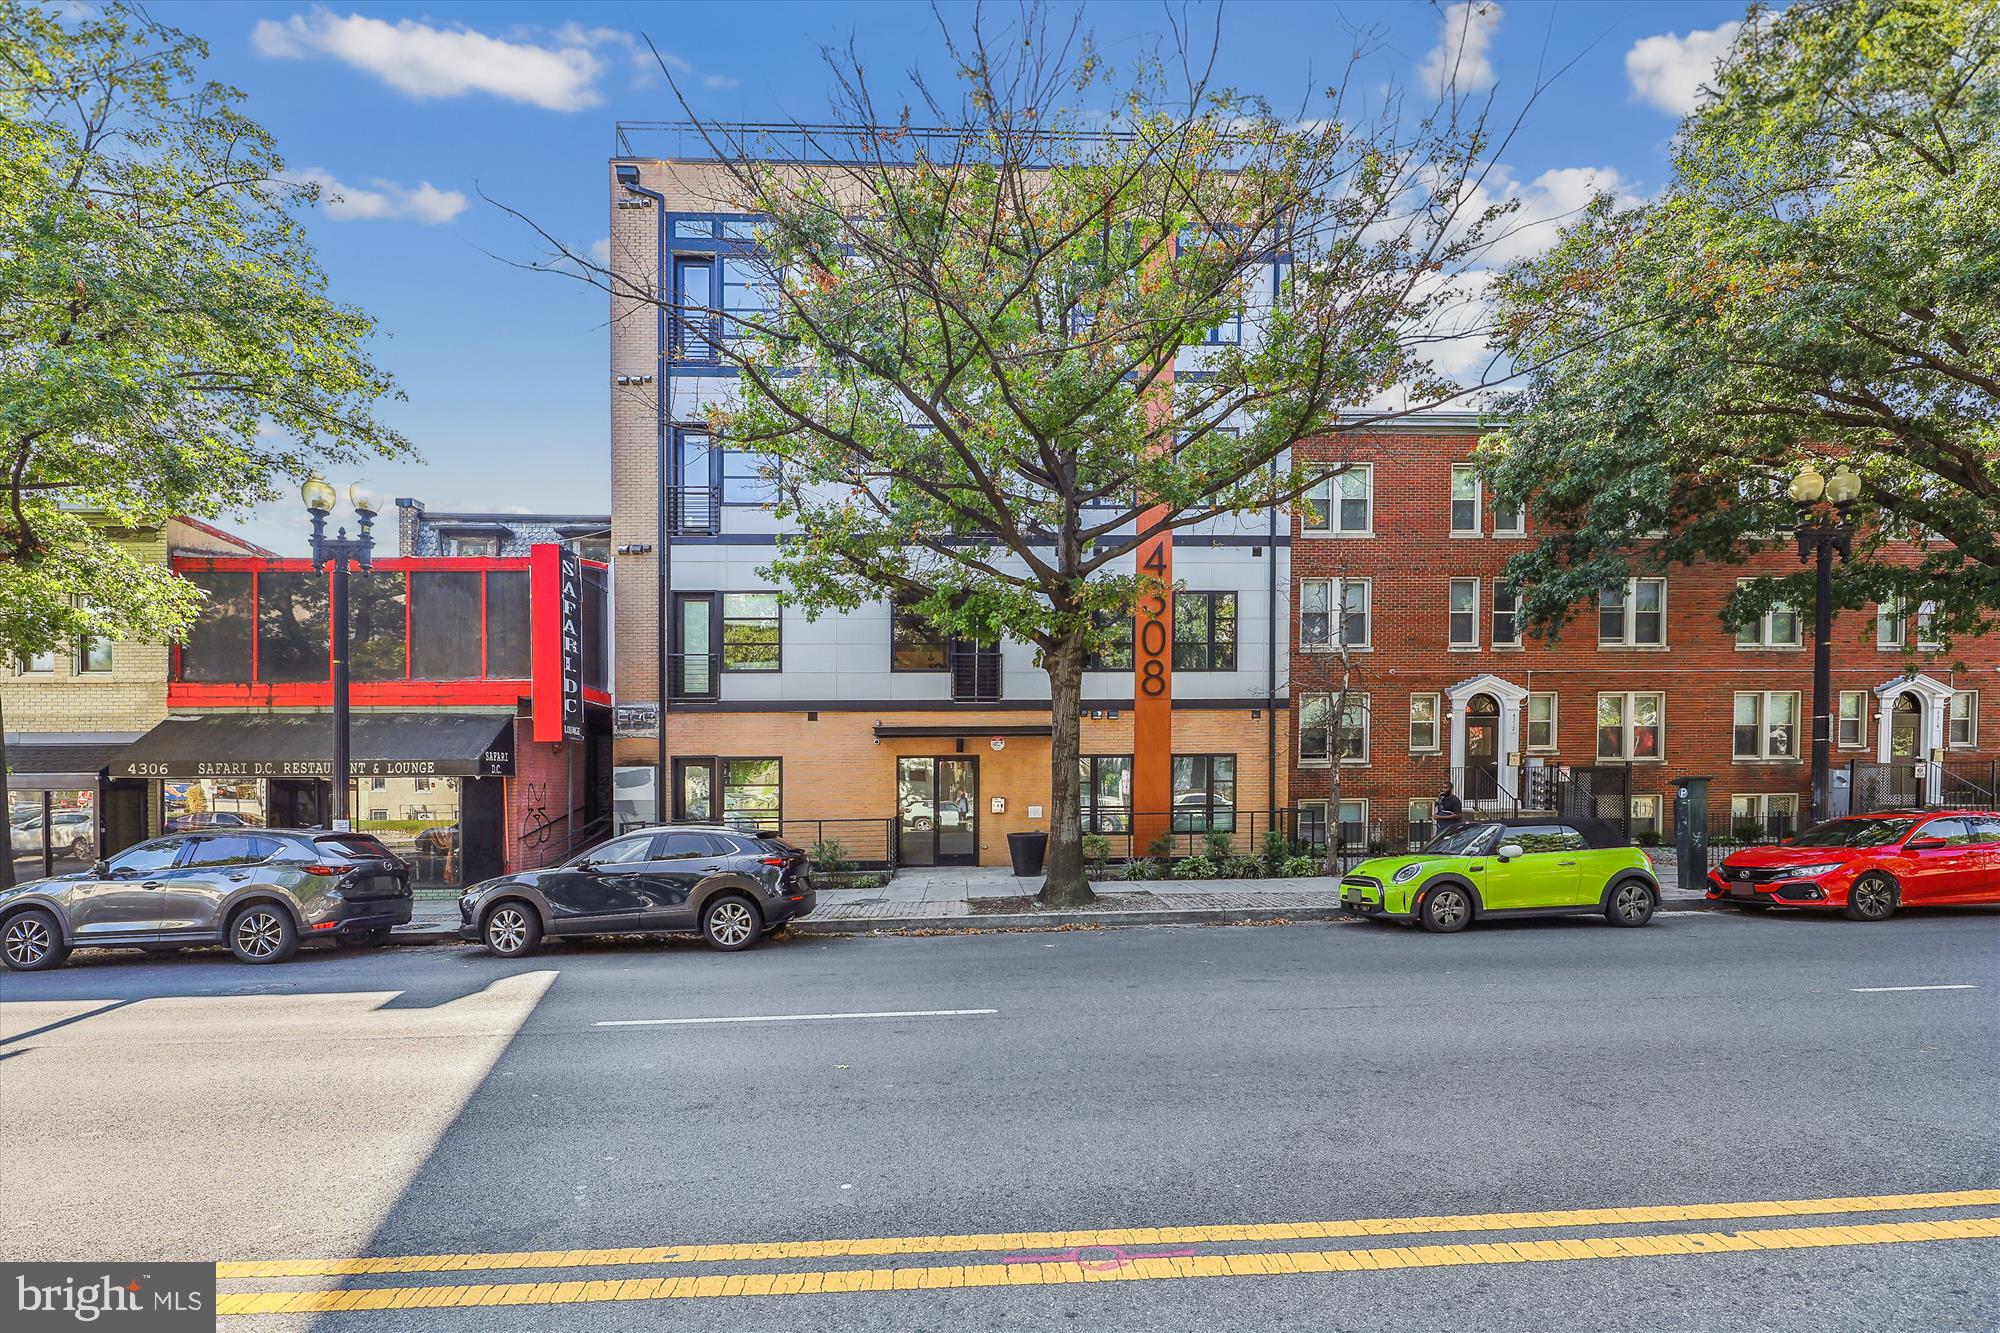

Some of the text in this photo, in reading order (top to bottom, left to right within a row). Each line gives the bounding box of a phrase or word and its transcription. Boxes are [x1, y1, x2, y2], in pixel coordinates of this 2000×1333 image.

[485, 751, 509, 762] SAFARI
[127, 763, 169, 775] 4306
[198, 762, 435, 774] SAFARI D.C. RESTAUNT & LOUNGE
[491, 764, 502, 774] D.C.
